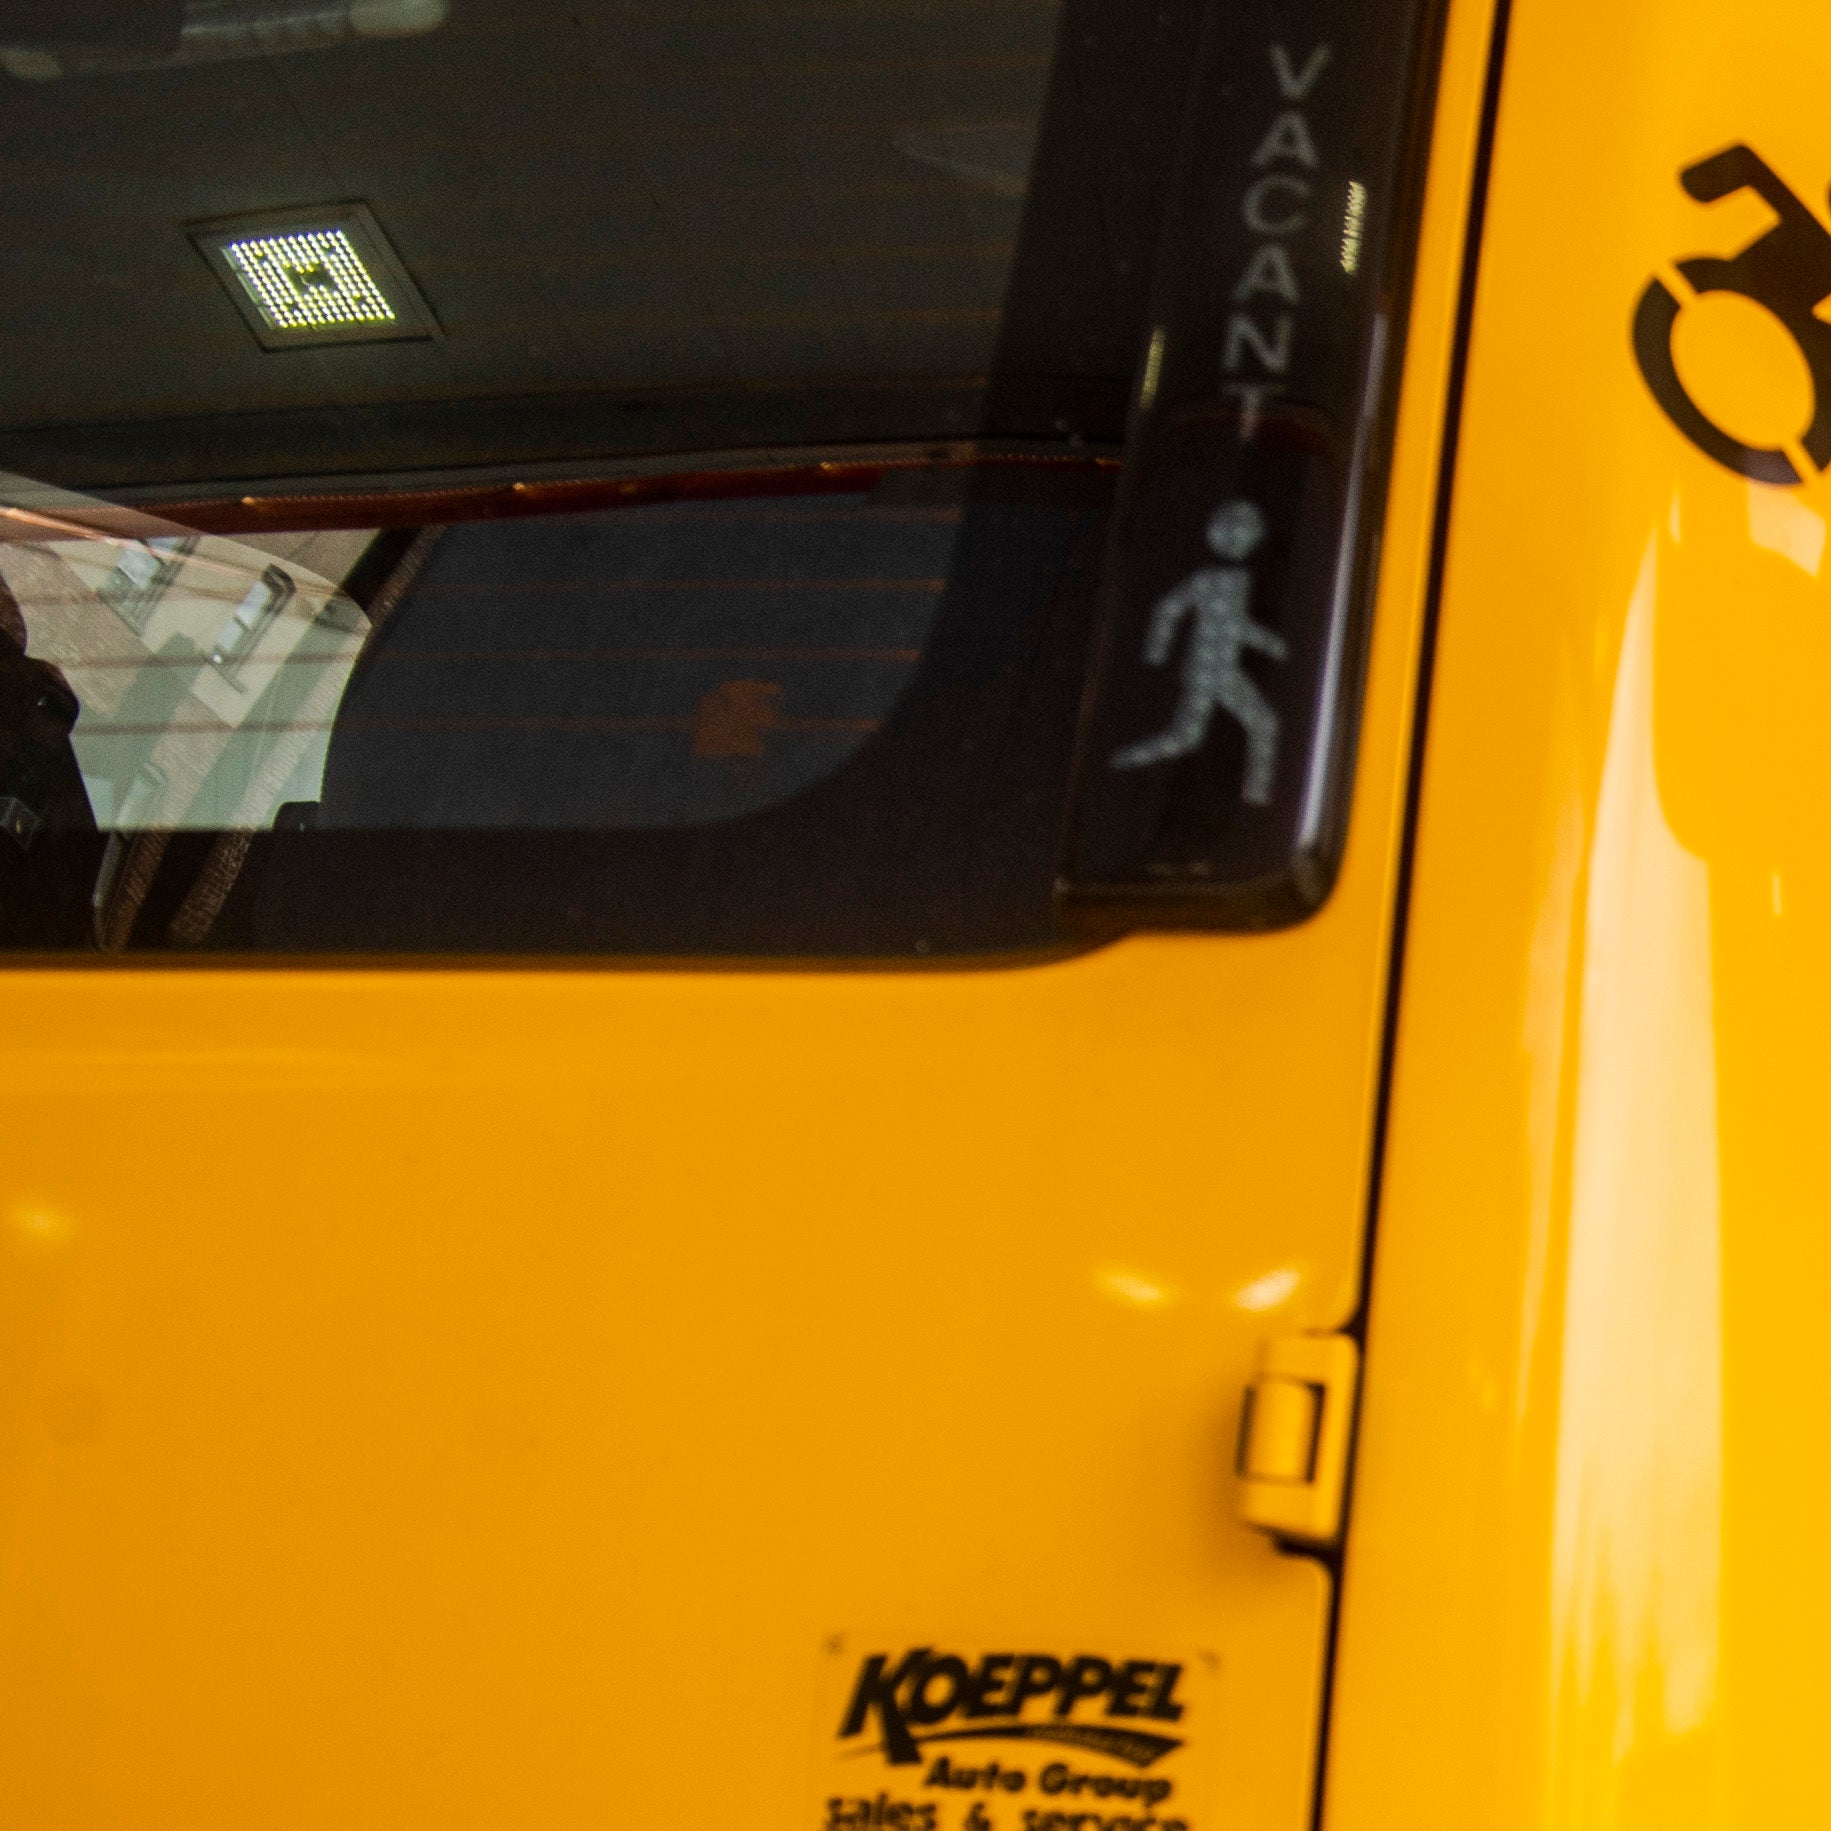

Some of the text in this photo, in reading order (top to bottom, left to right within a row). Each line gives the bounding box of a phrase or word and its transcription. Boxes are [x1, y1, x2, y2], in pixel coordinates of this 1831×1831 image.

[1220, 44, 1332, 441] VACANT
[837, 1646, 1186, 1765] KOEPPEL
[923, 1756, 1173, 1808] Auto Group
